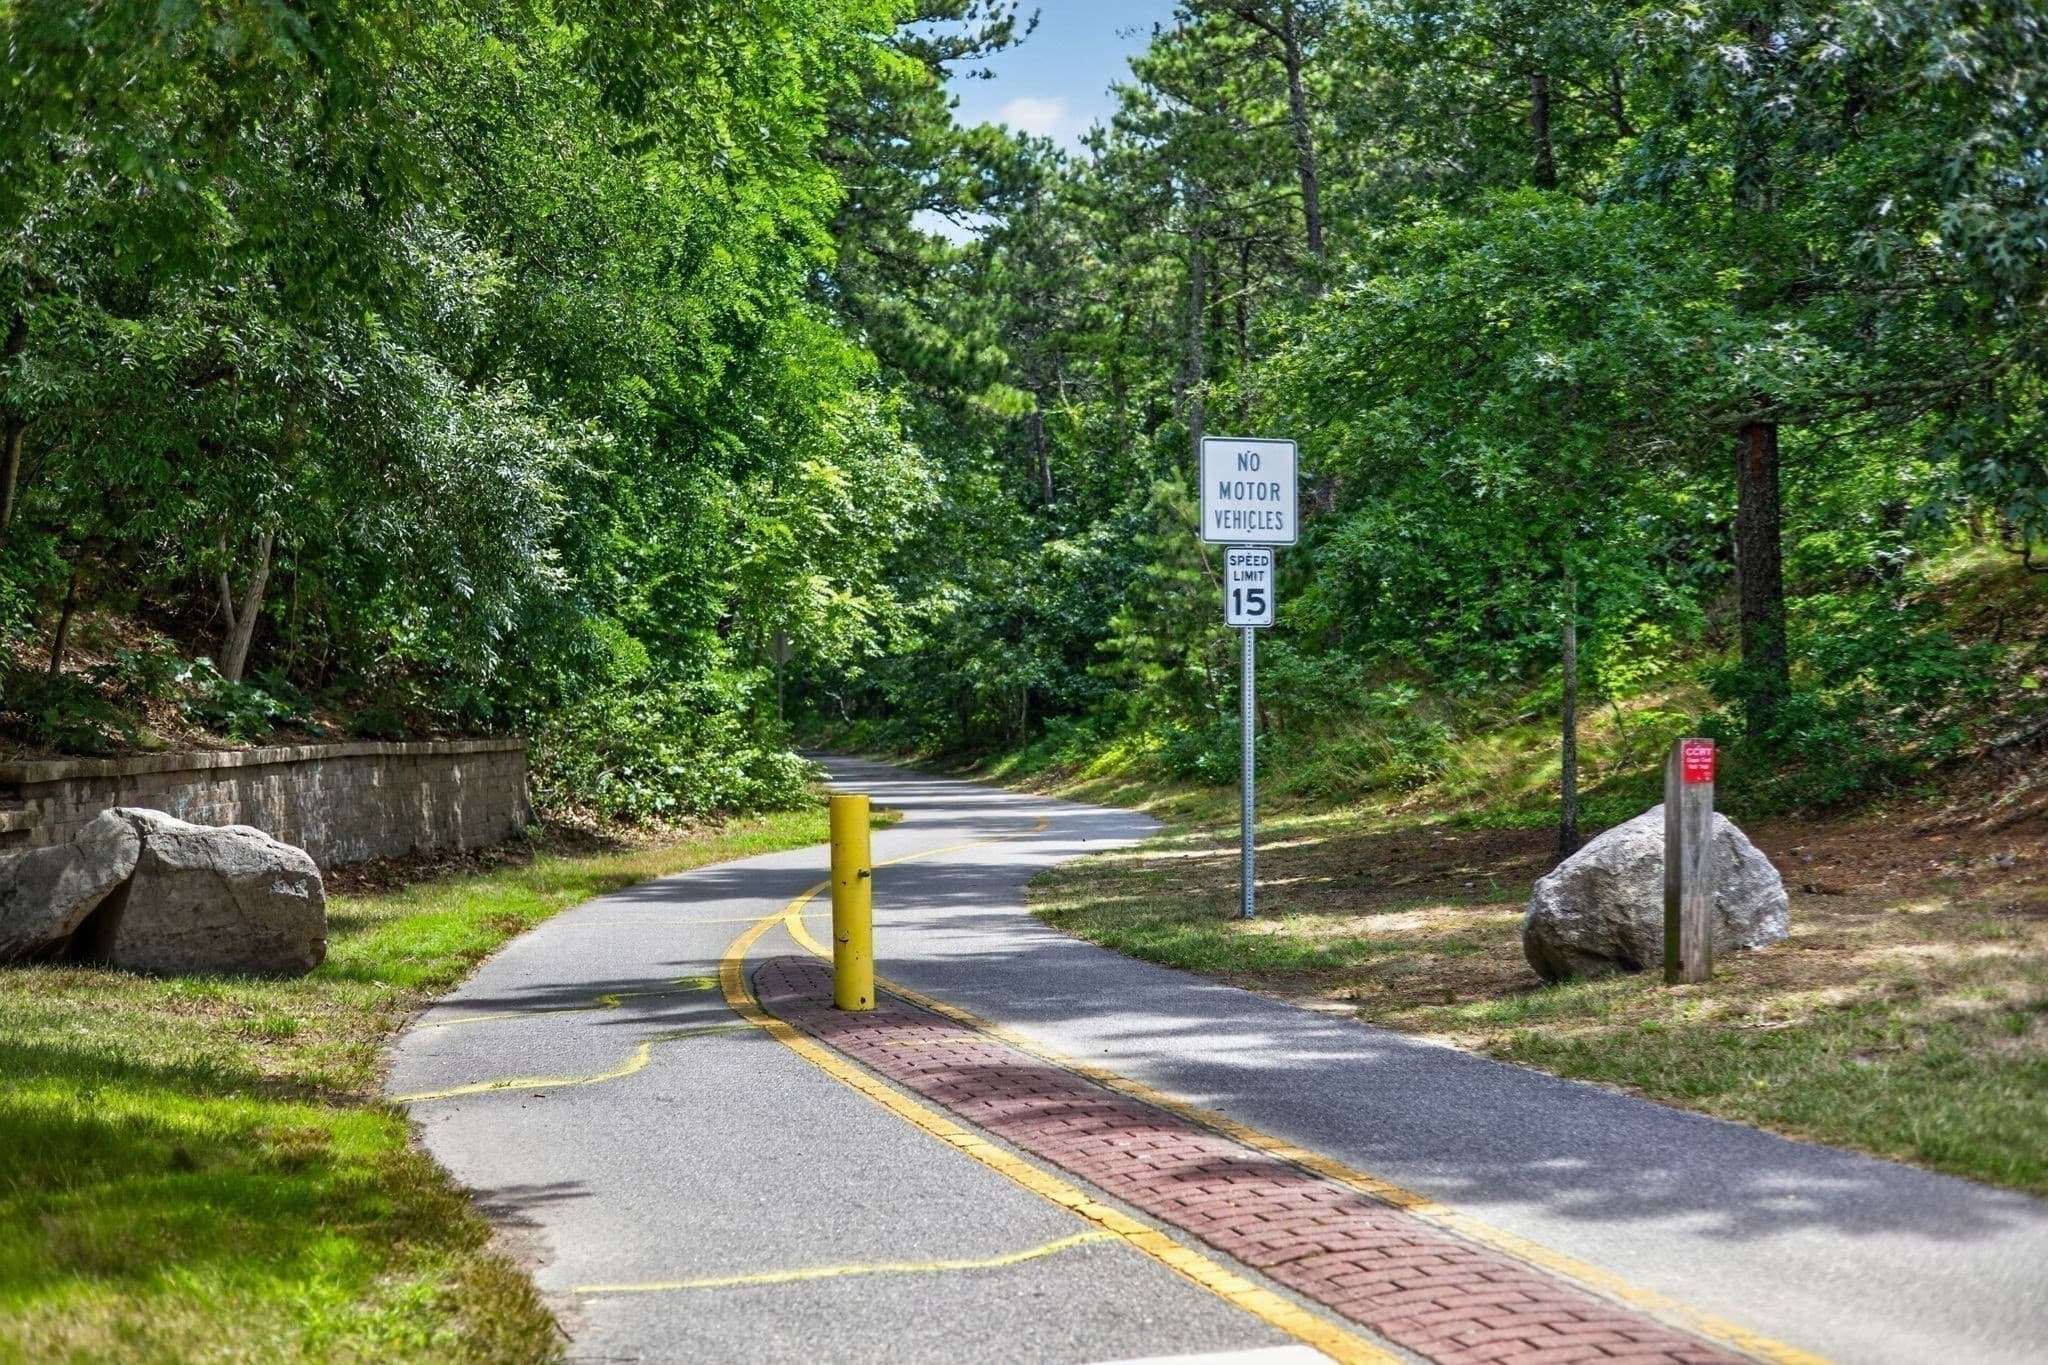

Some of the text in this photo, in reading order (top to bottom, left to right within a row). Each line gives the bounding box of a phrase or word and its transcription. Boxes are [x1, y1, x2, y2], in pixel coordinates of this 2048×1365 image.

[1238, 453, 1260, 471] NO
[1219, 481, 1280, 501] MOTOR
[1214, 510, 1283, 530] VEHICLES
[1229, 555, 1269, 567] SPEED
[1233, 571, 1264, 581] LIMIT
[1232, 588, 1266, 616] 15
